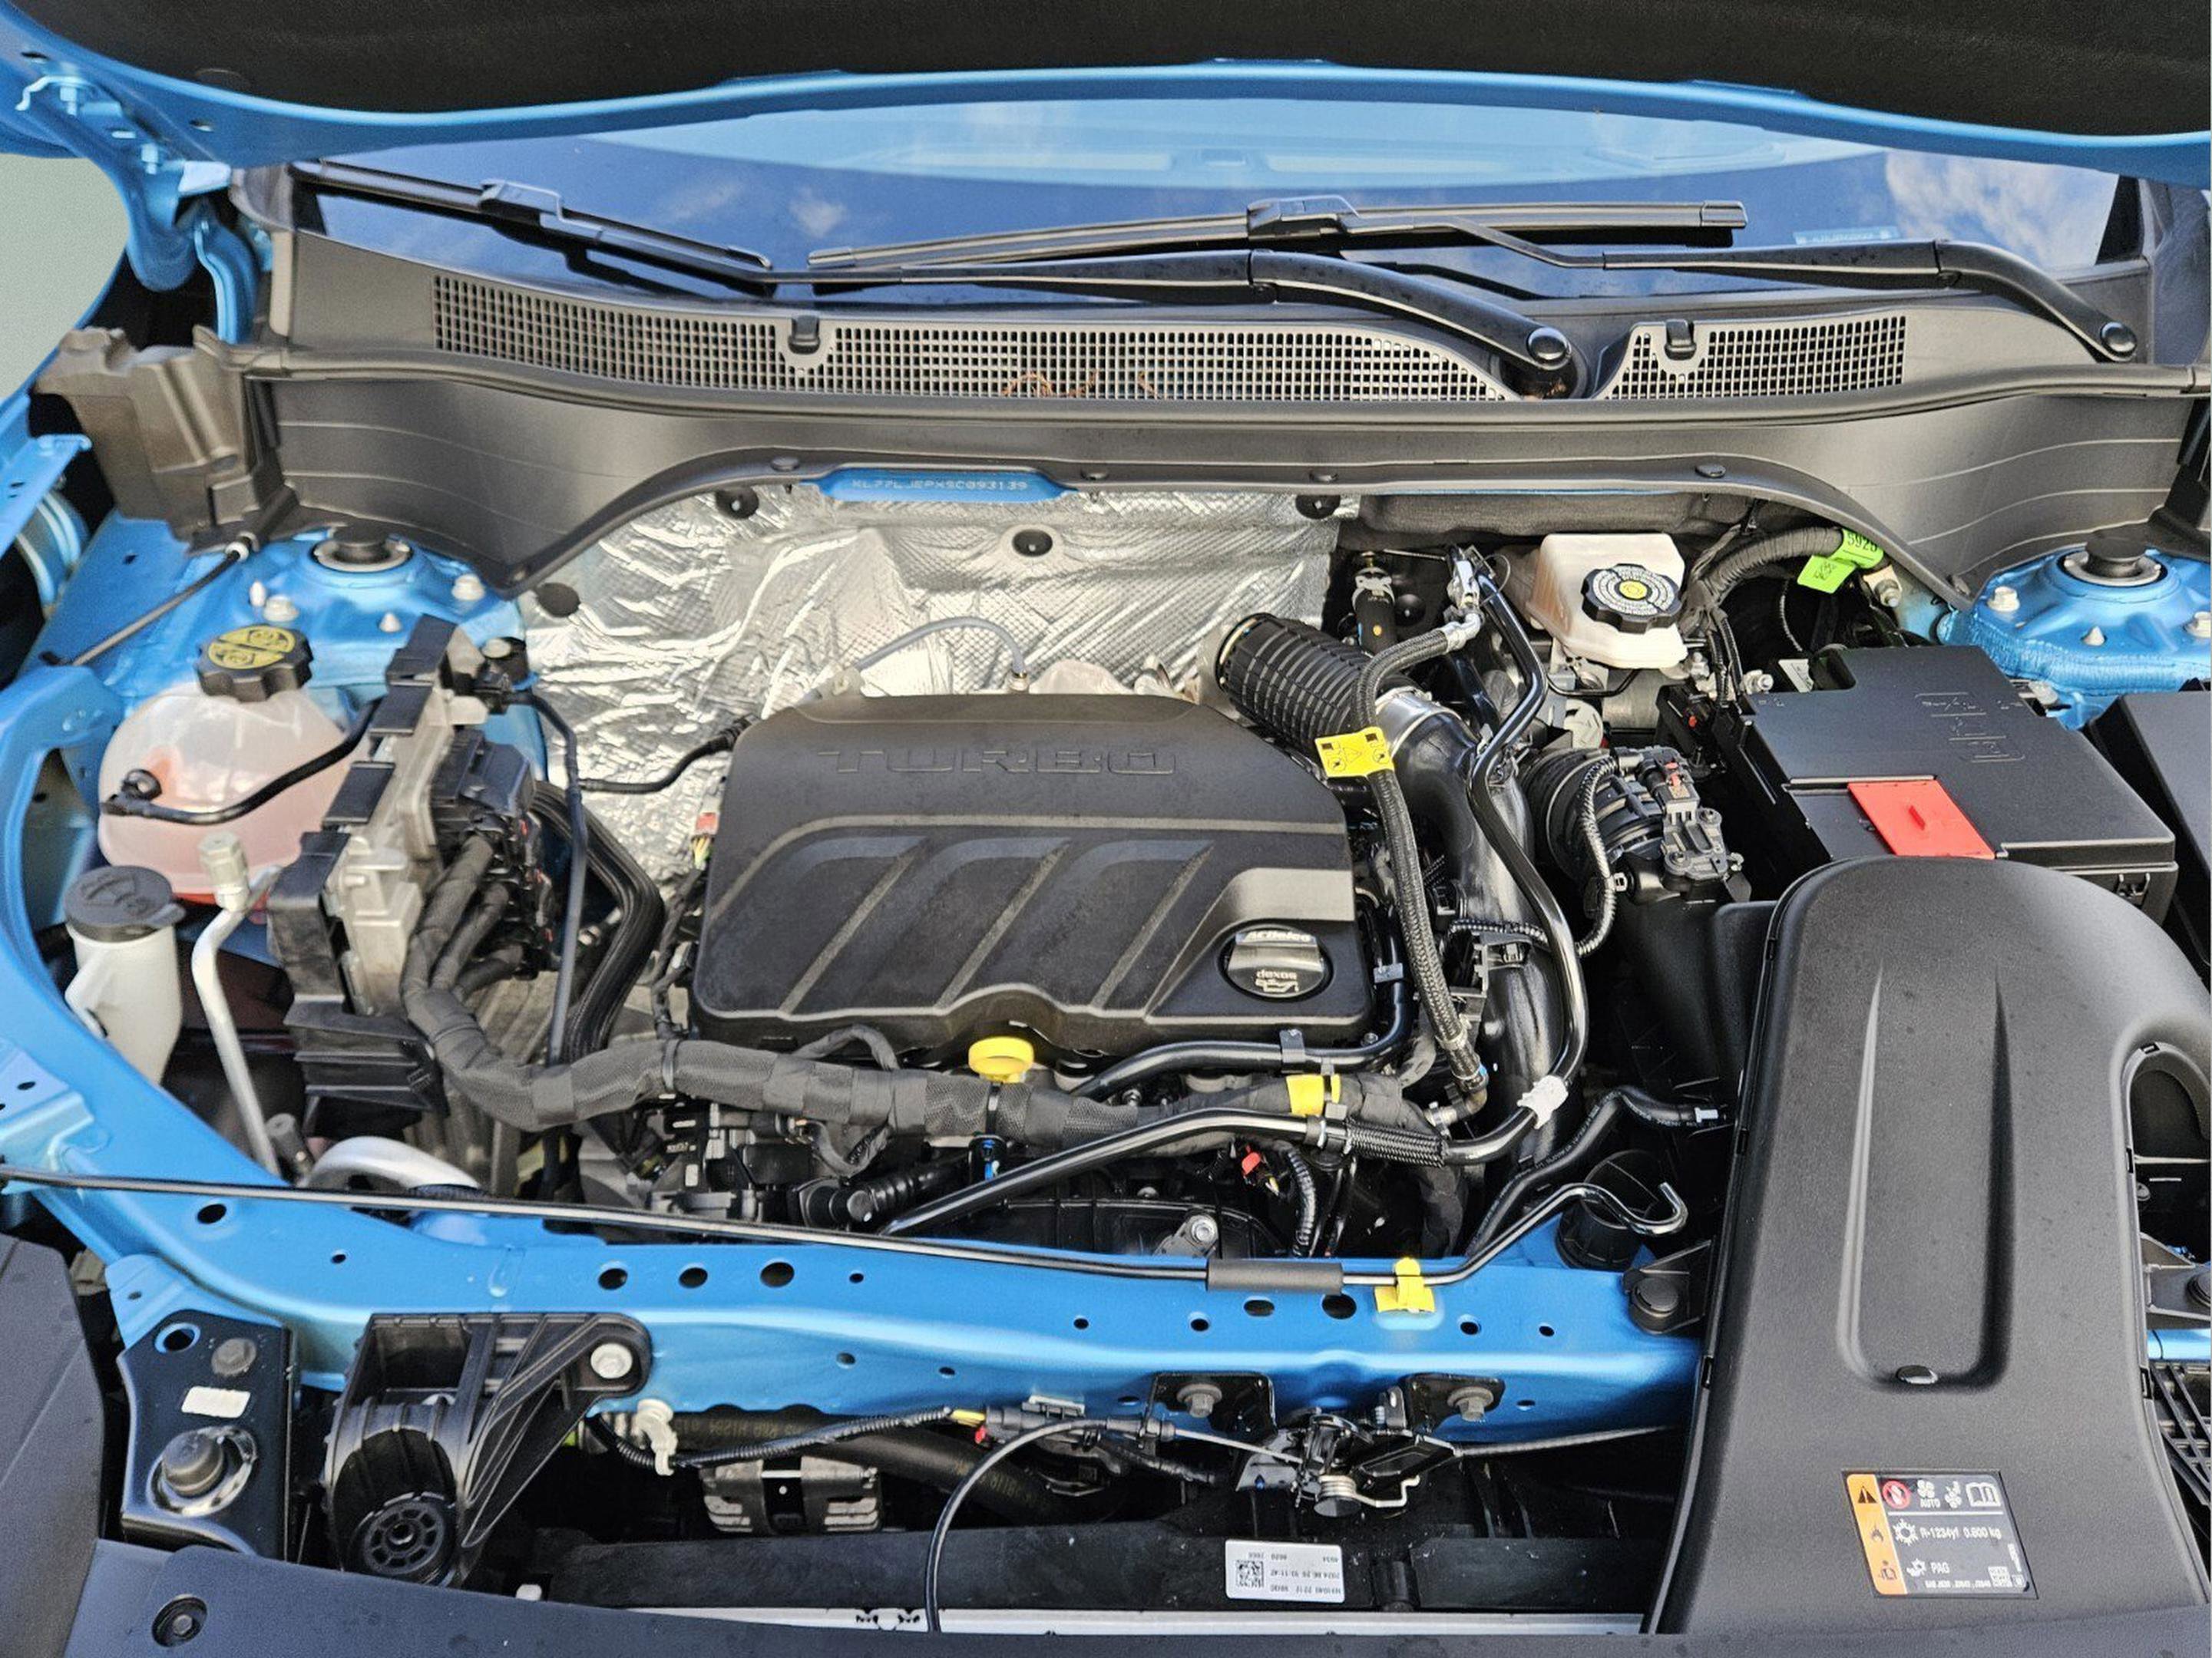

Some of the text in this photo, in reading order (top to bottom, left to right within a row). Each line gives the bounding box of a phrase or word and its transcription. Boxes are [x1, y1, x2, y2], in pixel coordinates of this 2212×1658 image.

[817, 748, 1176, 775] TURBO
[1256, 969, 1298, 980] dexos
[1930, 1561, 1950, 1574] PAG
